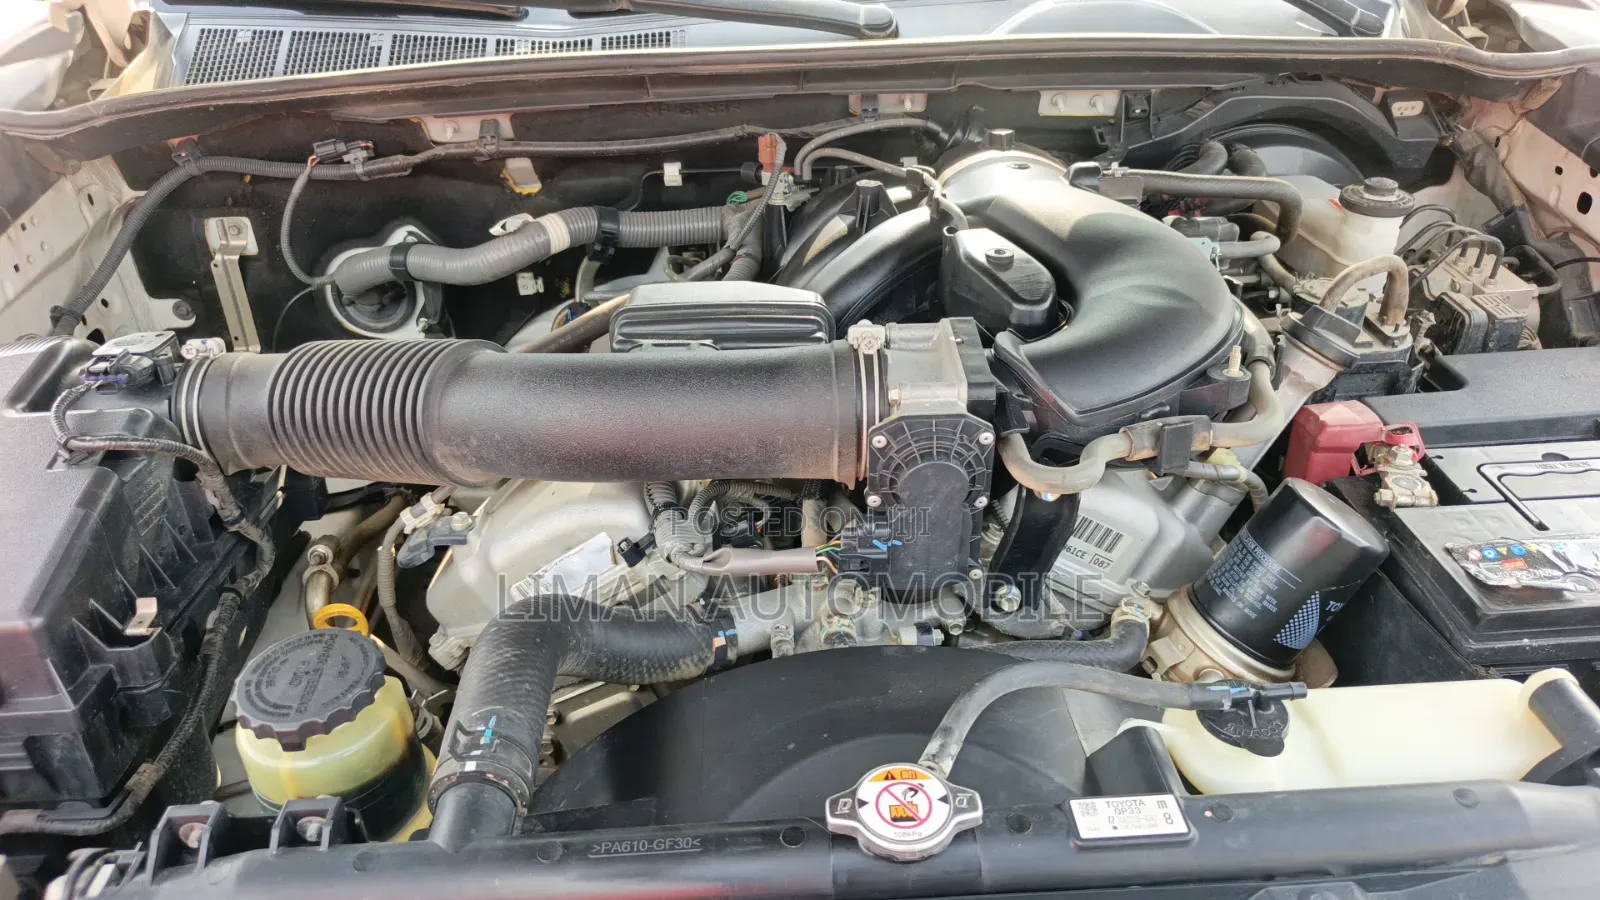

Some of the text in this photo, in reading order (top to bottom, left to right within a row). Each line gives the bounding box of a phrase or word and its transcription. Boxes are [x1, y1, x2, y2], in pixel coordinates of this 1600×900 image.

[1092, 557, 1111, 570] 087
[1105, 799, 1147, 809] TOYOTA
[1163, 812, 1174, 825] 8
[591, 836, 702, 854] >PA610-GF30<
